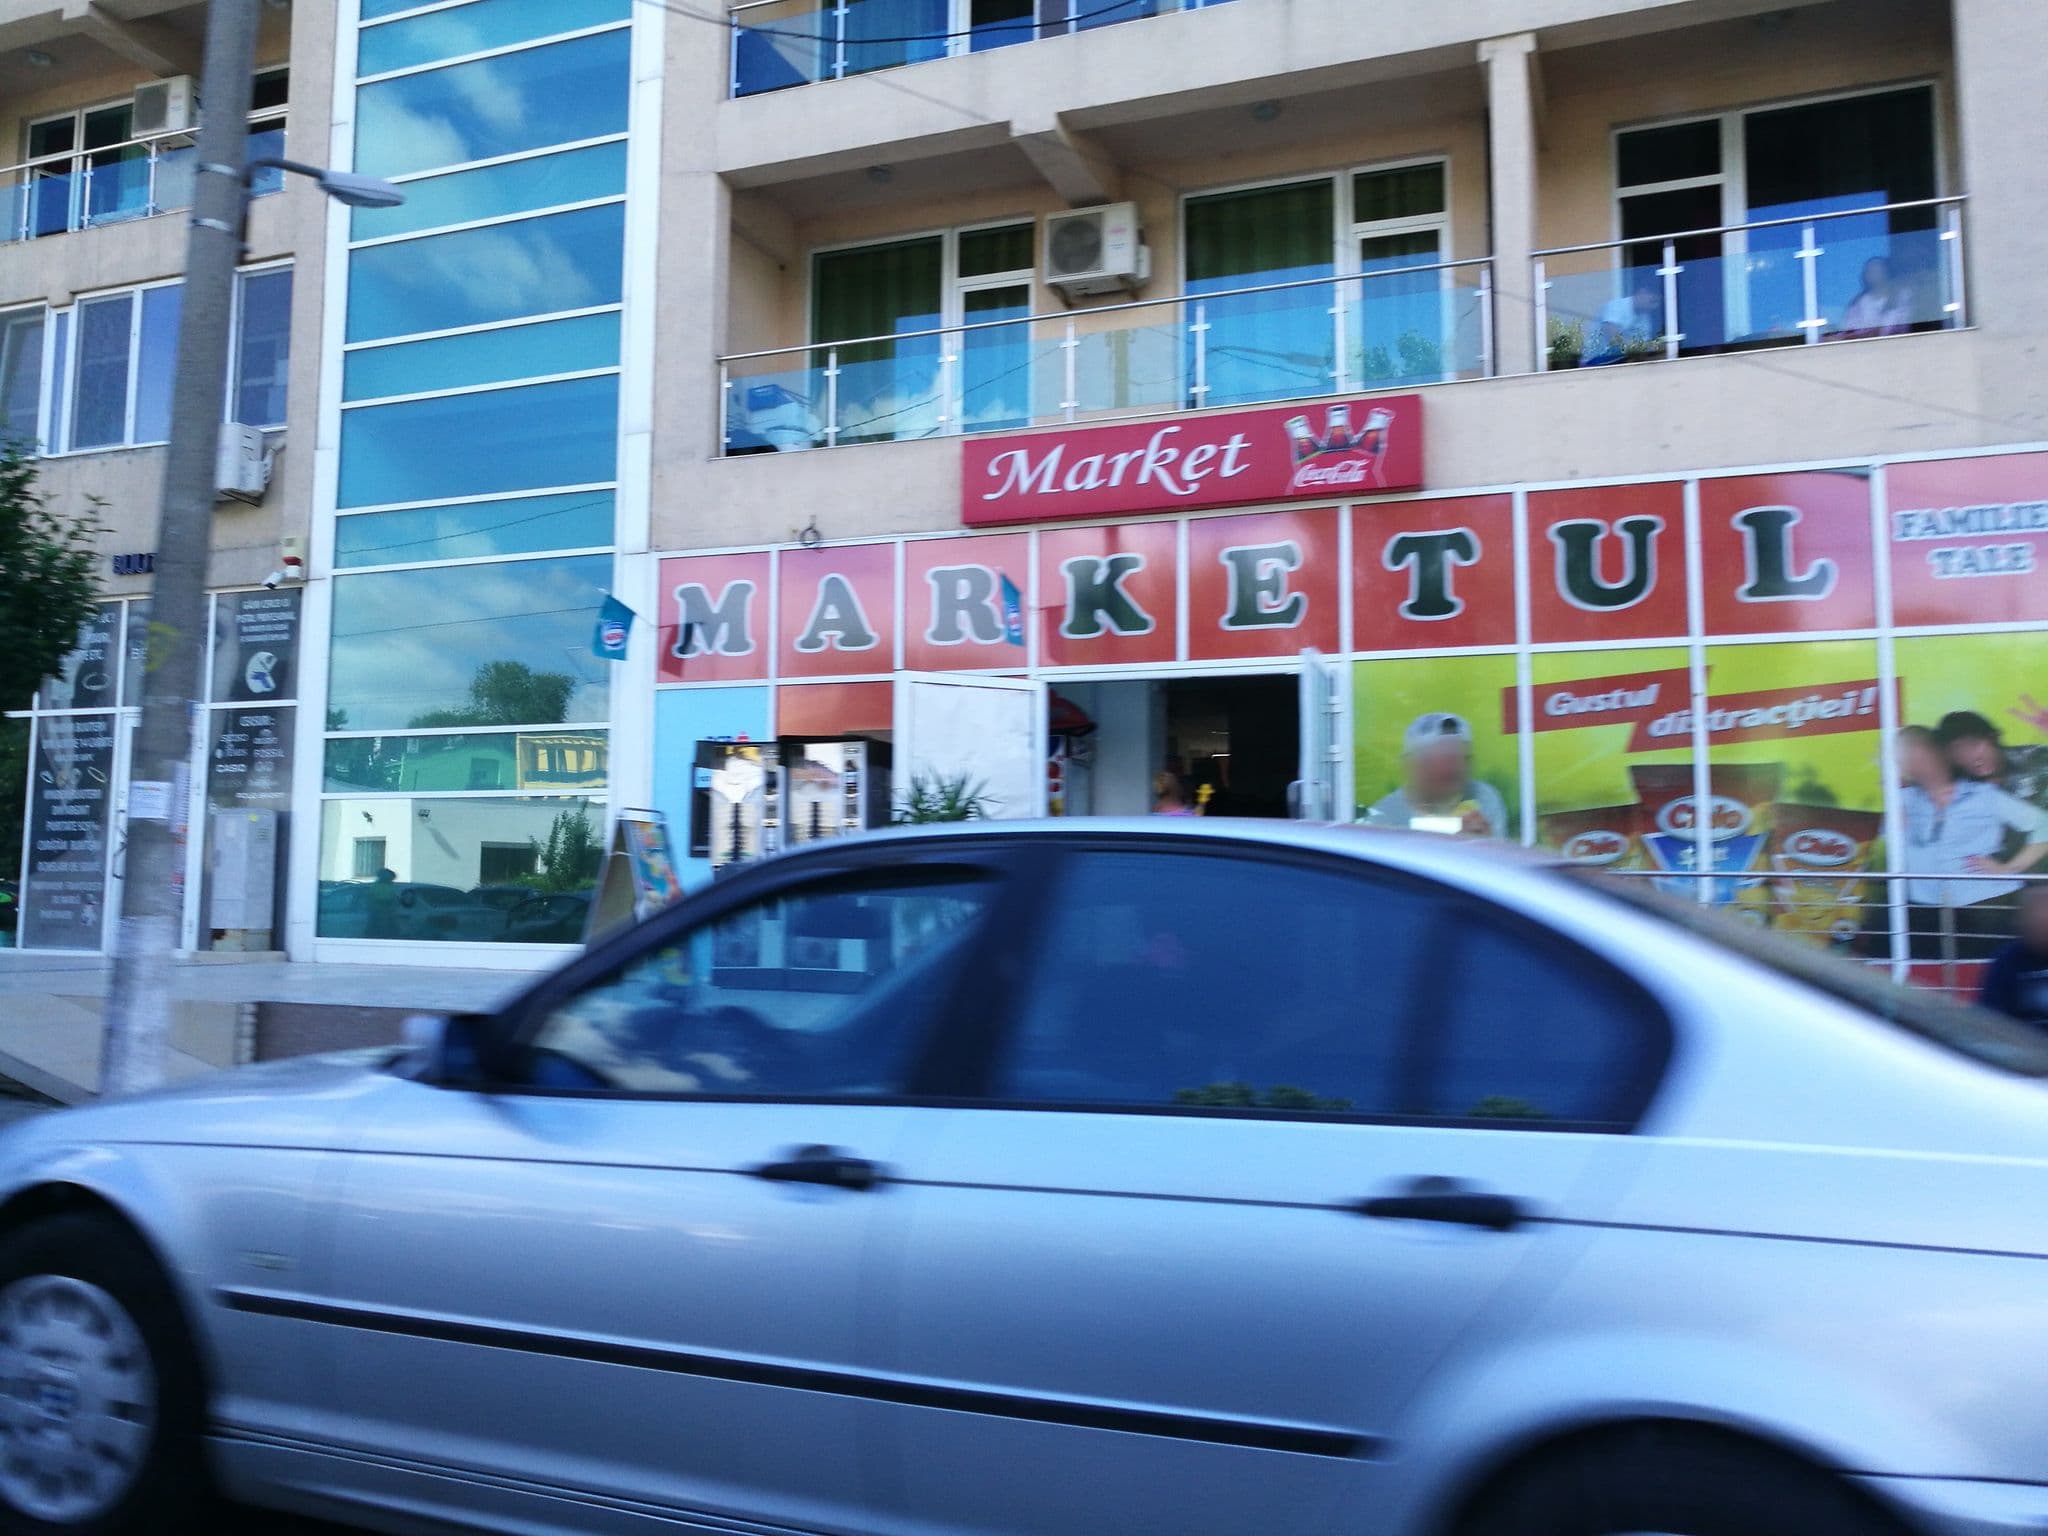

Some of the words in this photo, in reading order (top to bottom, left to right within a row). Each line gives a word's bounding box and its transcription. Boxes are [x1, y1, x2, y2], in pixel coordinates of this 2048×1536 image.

[982, 426, 1252, 500] Market
[1293, 459, 1370, 487] Coca-Cola
[1927, 542, 2036, 578] TALE
[672, 505, 1839, 658] MARKETUL
[1544, 683, 1661, 716] Gustul
